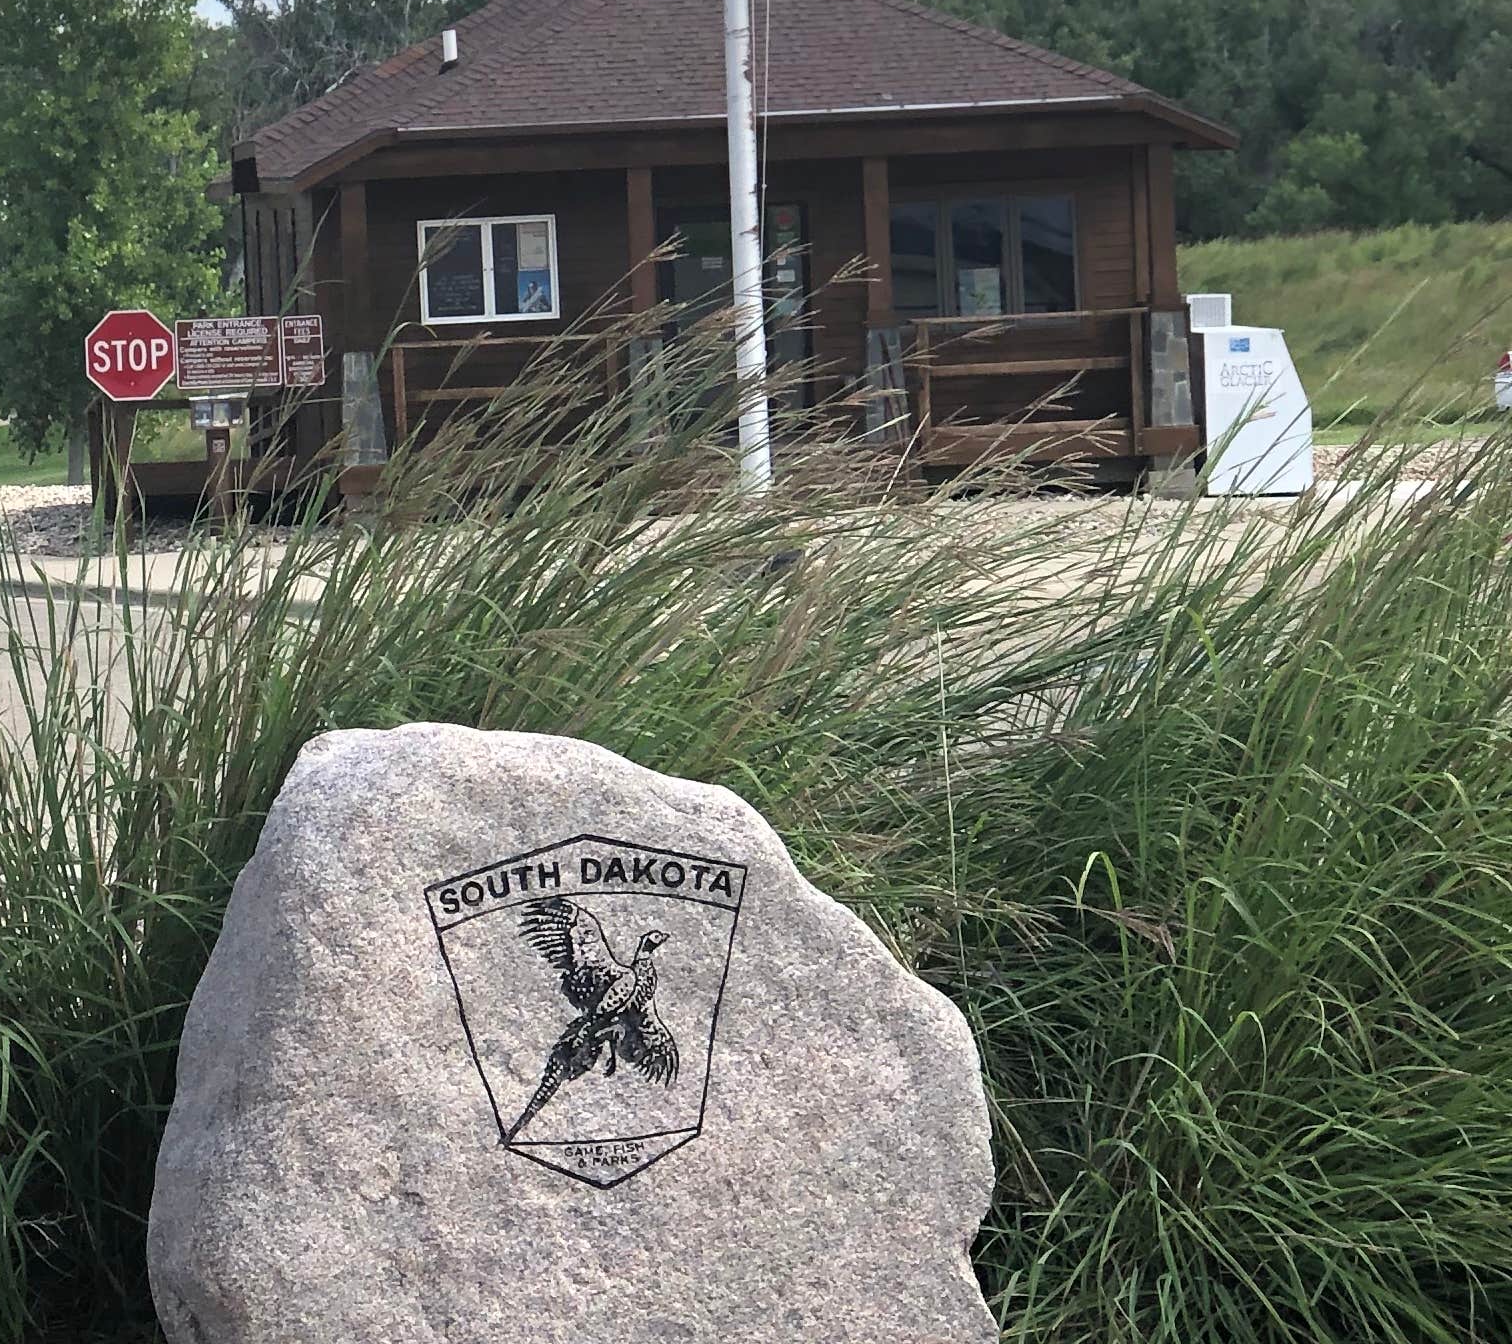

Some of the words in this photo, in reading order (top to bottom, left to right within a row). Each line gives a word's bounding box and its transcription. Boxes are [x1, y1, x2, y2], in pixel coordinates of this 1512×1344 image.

[192, 321, 214, 329] PARK
[217, 319, 262, 328] ENTRANCE
[187, 329, 222, 337] LICENSE
[225, 327, 268, 336] REQUIRED
[93, 338, 168, 373] STOP
[1220, 360, 1273, 376] ARCTIC
[439, 861, 561, 915] SOUTH
[580, 857, 732, 897] DAKOTA
[613, 1141, 645, 1154] FISH
[592, 1153, 641, 1166] PARKS
